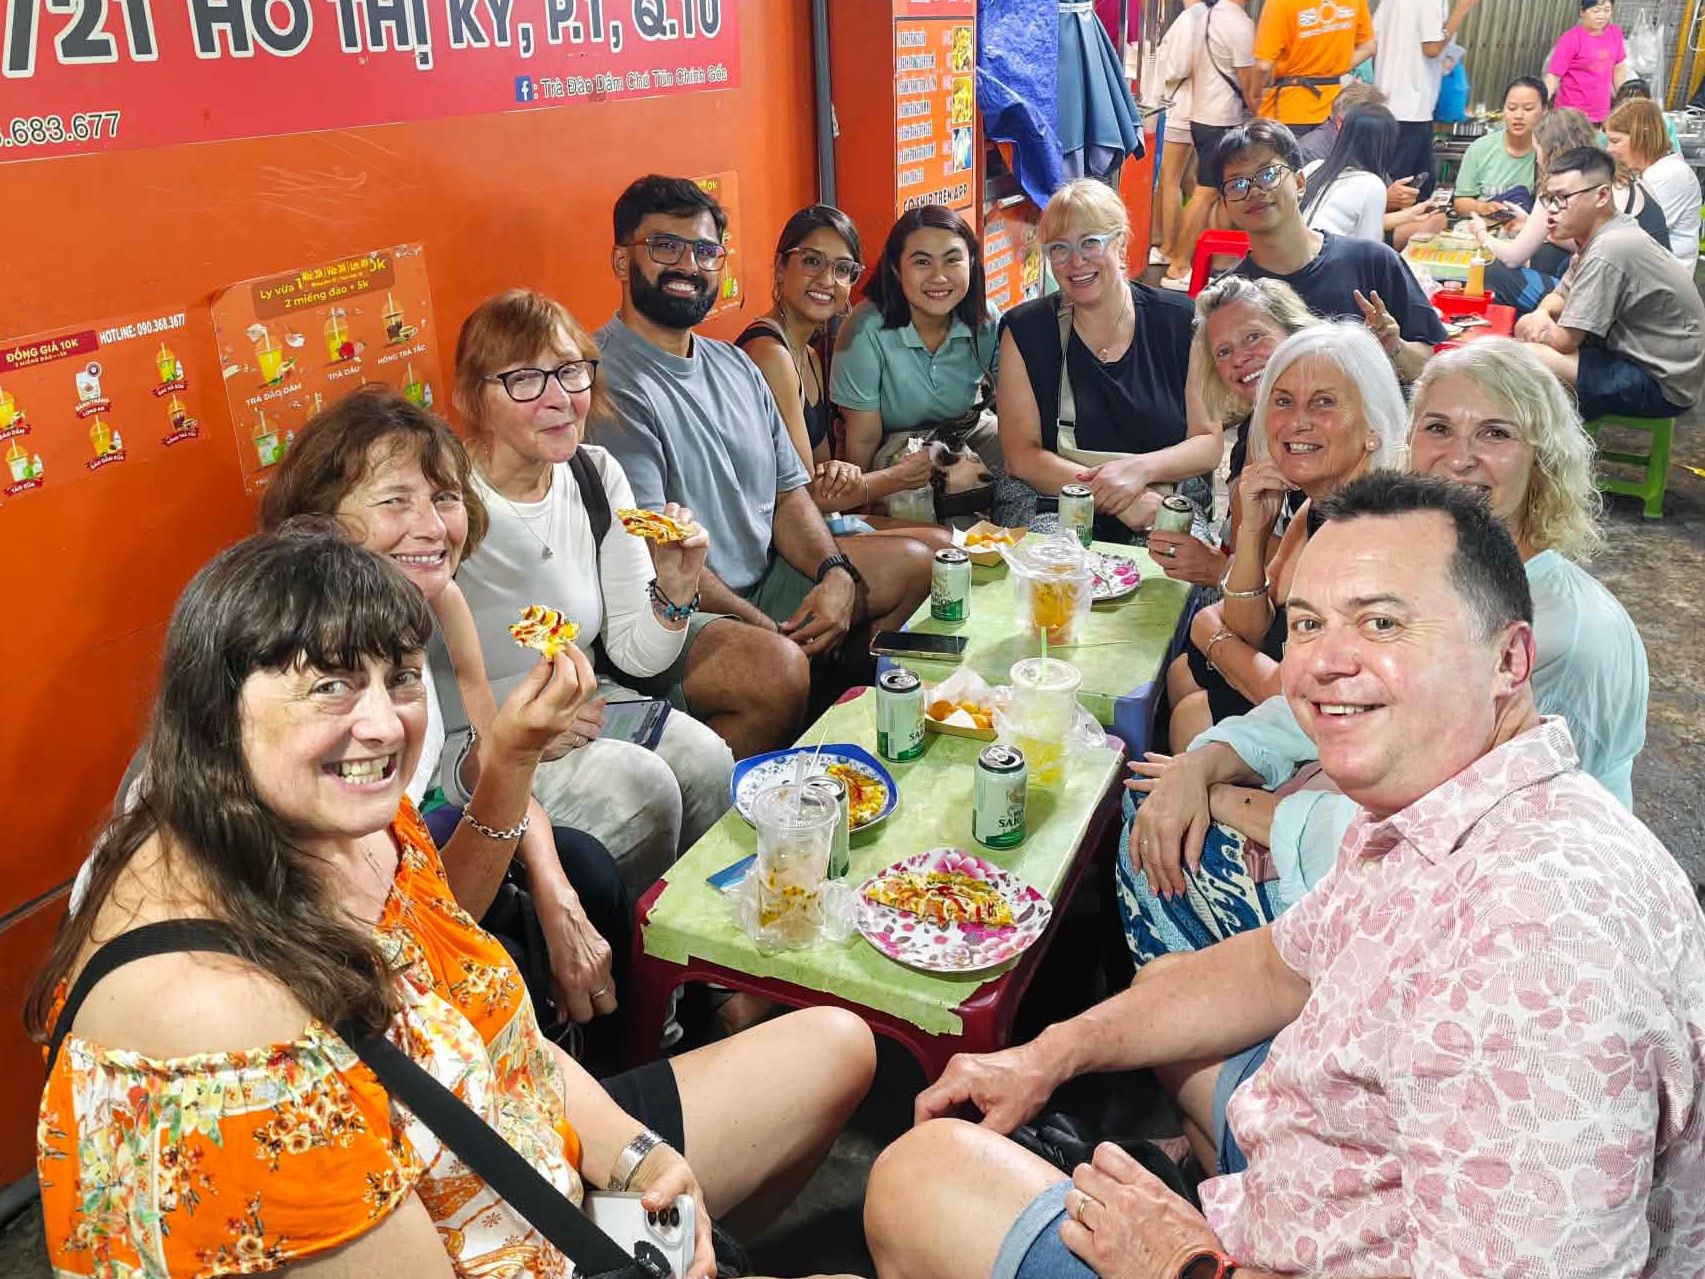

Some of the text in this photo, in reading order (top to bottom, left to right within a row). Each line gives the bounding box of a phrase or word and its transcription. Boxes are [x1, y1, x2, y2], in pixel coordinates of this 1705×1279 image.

[327, 0, 433, 70] THỊ
[541, 77, 565, 98] Trà
[567, 76, 594, 96] Đào
[260, 288, 273, 300] Ly
[100, 326, 137, 345] HOTLINE:
[6, 346, 39, 362] ĐỒNG
[40, 340, 59, 354] GIÁ
[60, 338, 79, 350] 10K
